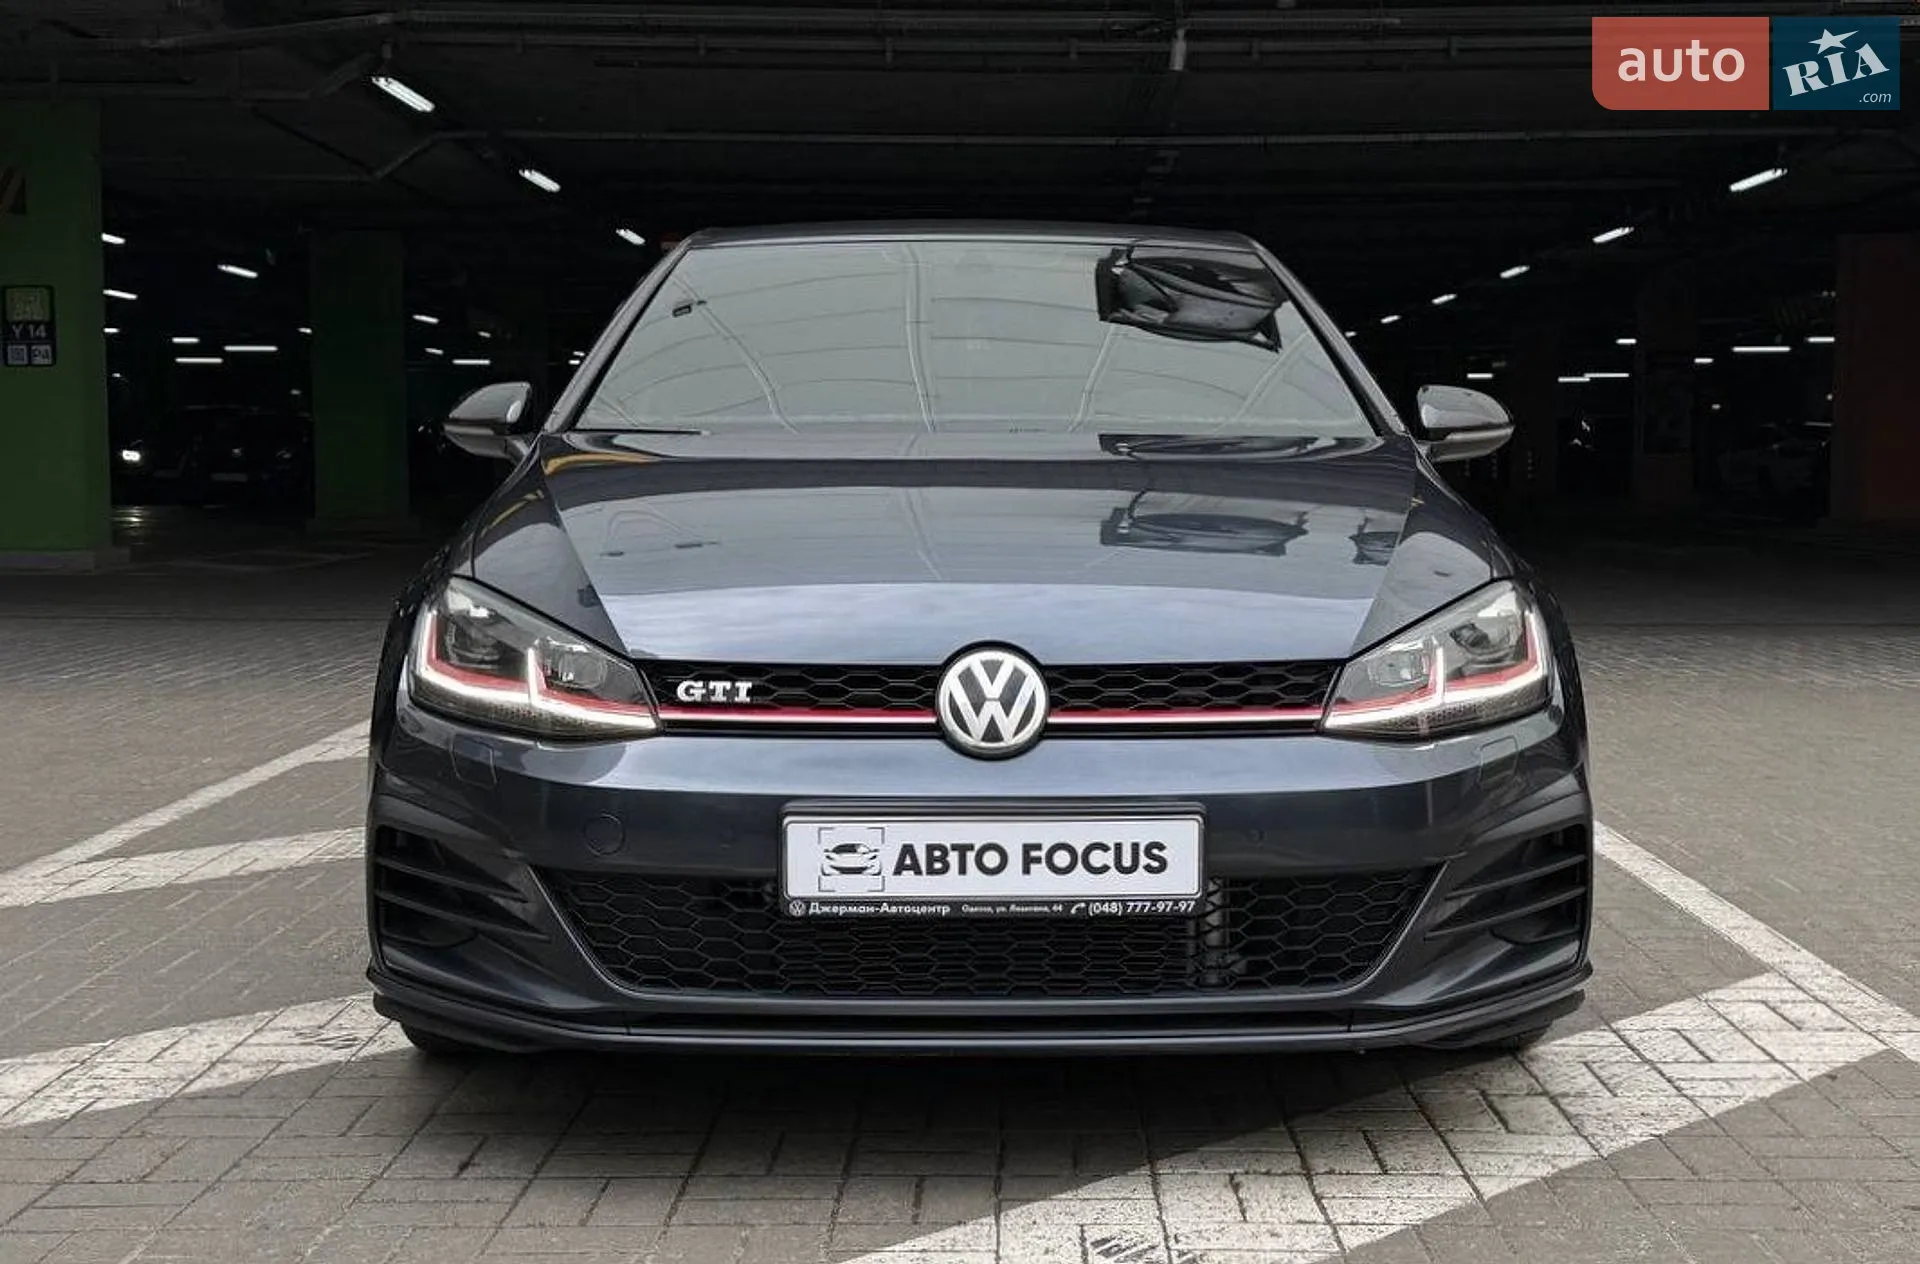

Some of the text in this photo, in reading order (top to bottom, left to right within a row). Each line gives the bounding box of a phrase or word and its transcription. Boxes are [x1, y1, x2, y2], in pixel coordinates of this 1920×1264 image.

[676, 680, 752, 702] GTI
[1021, 841, 1168, 876] FOCUS
[1125, 900, 1196, 914] 777-97-97
